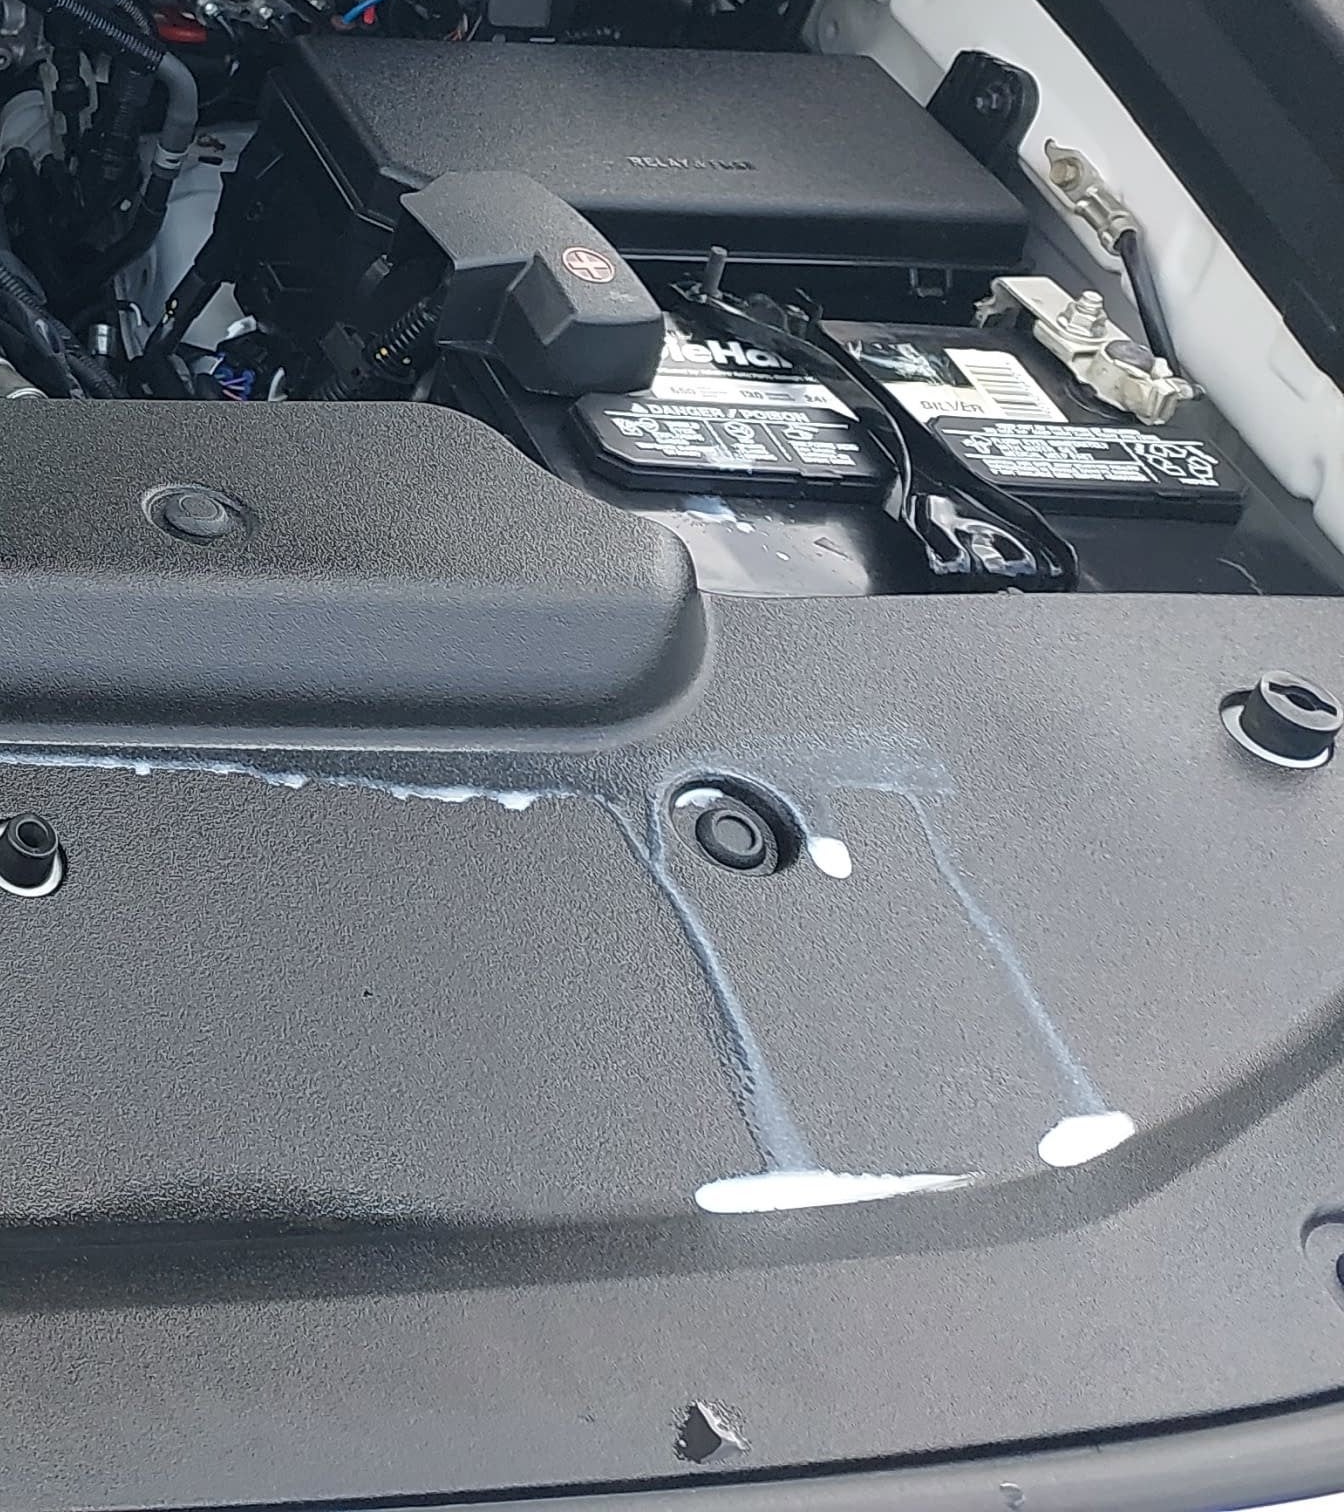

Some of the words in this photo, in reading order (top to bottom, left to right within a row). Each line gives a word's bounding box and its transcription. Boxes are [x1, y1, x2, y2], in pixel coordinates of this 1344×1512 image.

[627, 155, 689, 169] RELAY
[647, 403, 725, 419] DANGER
[738, 408, 811, 423] POISON
[920, 400, 985, 414] SILVER
